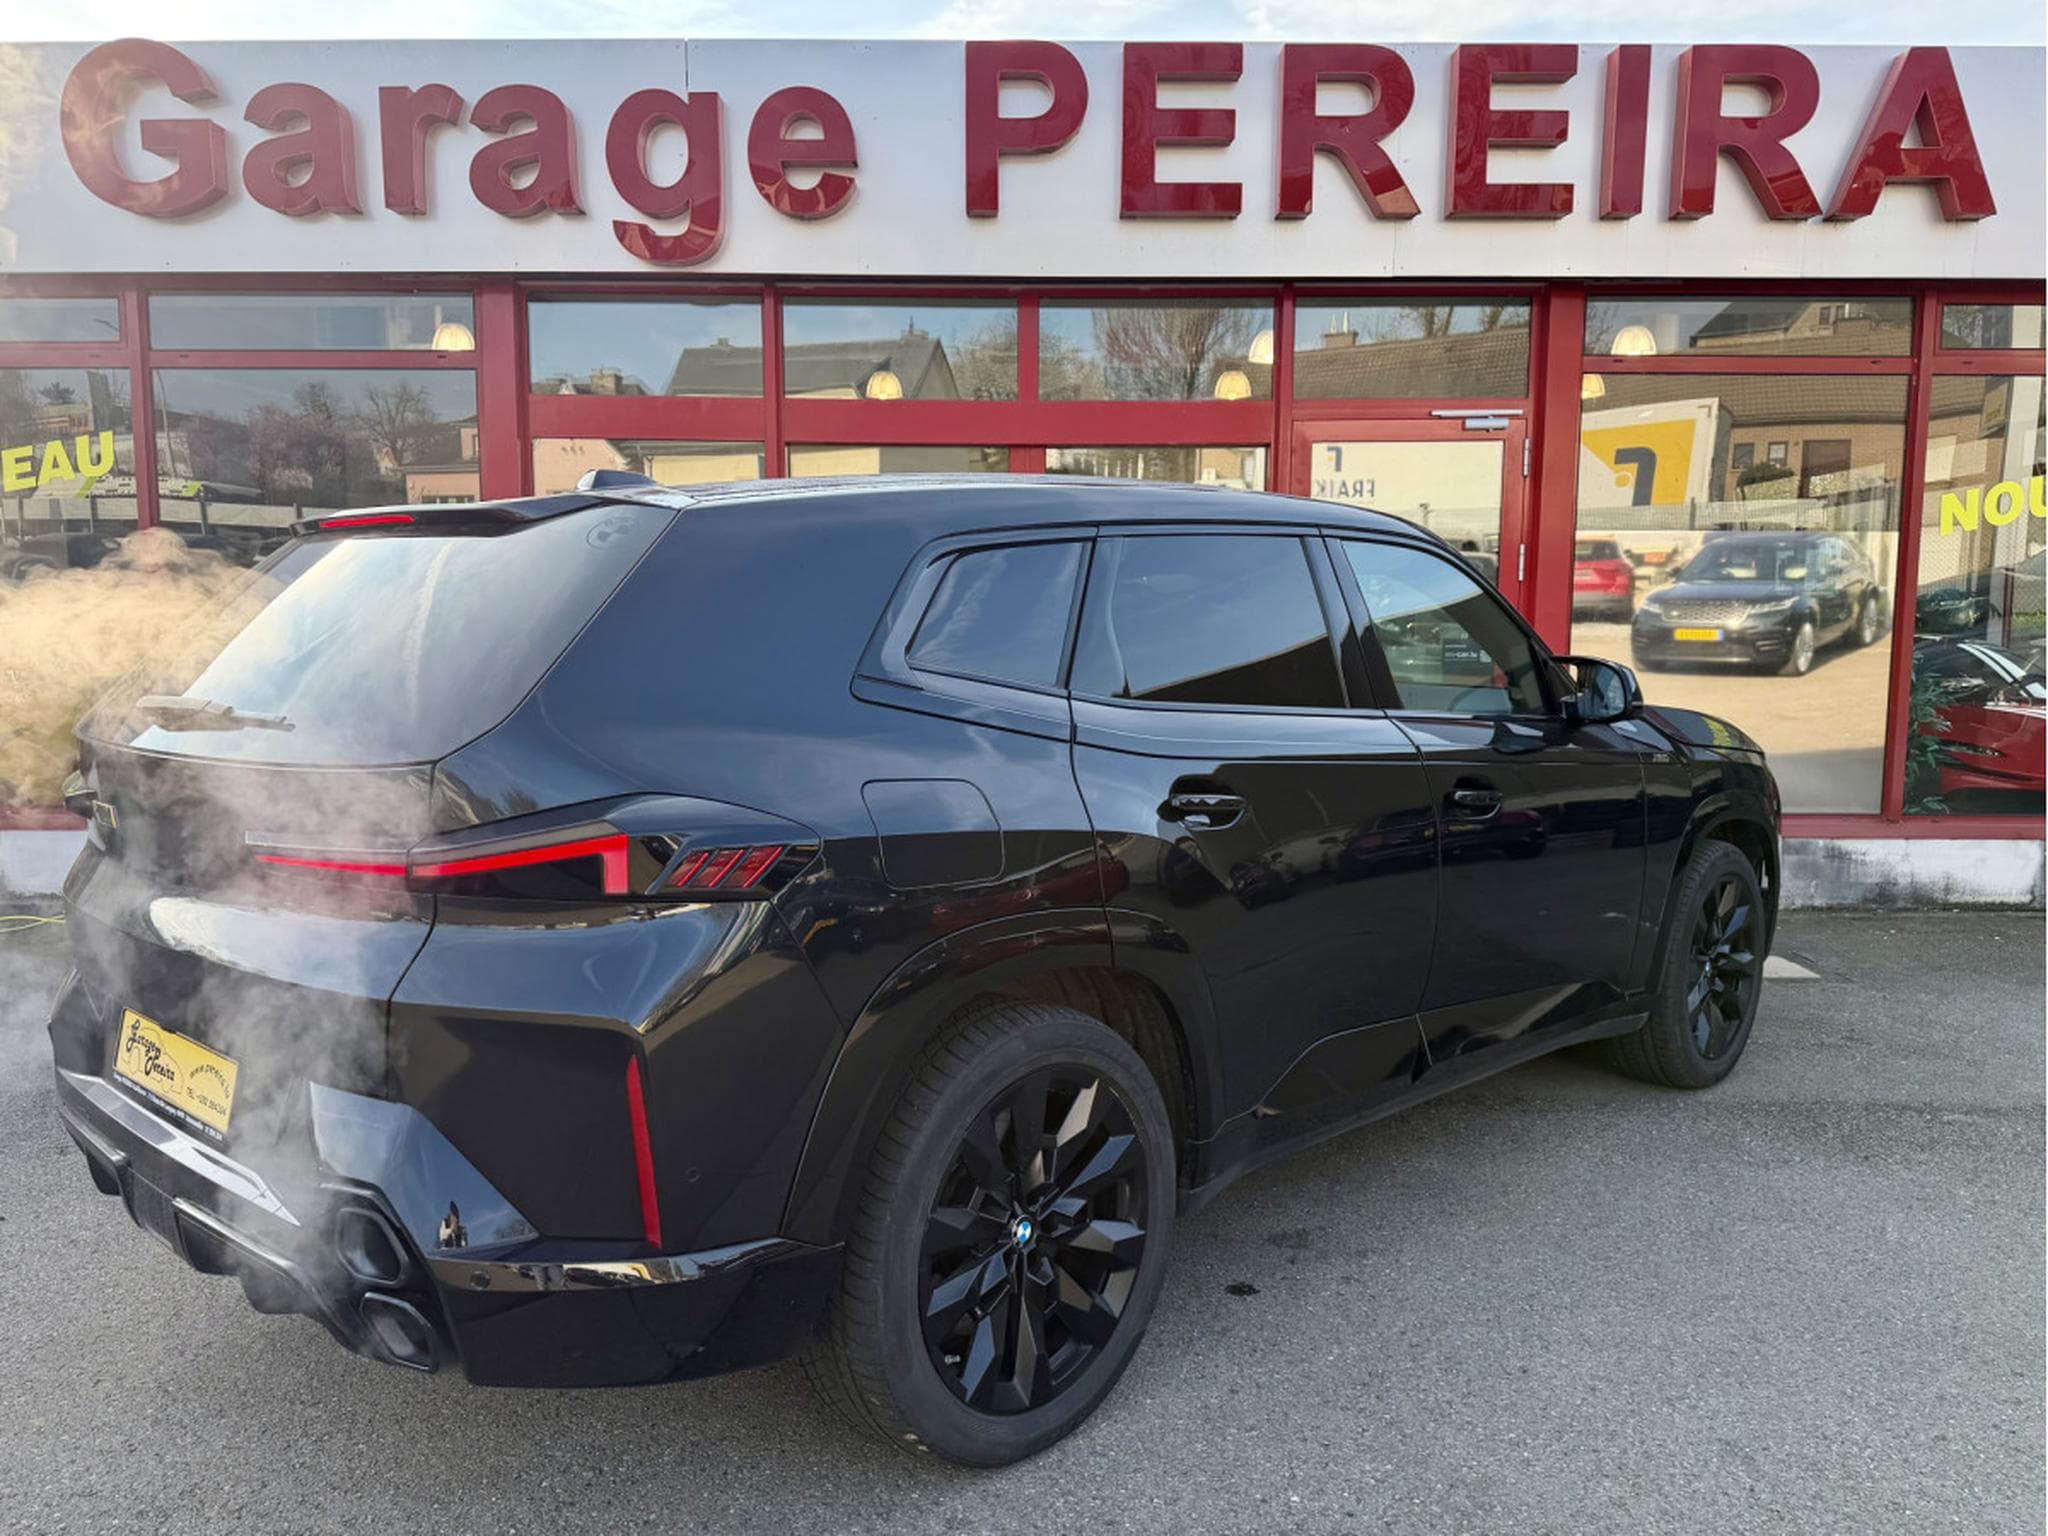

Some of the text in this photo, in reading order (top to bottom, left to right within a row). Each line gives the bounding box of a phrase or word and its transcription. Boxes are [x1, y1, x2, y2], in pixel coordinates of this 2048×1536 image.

[60, 36, 1998, 266] Garage PEREIRA
[1, 429, 115, 493] EAU
